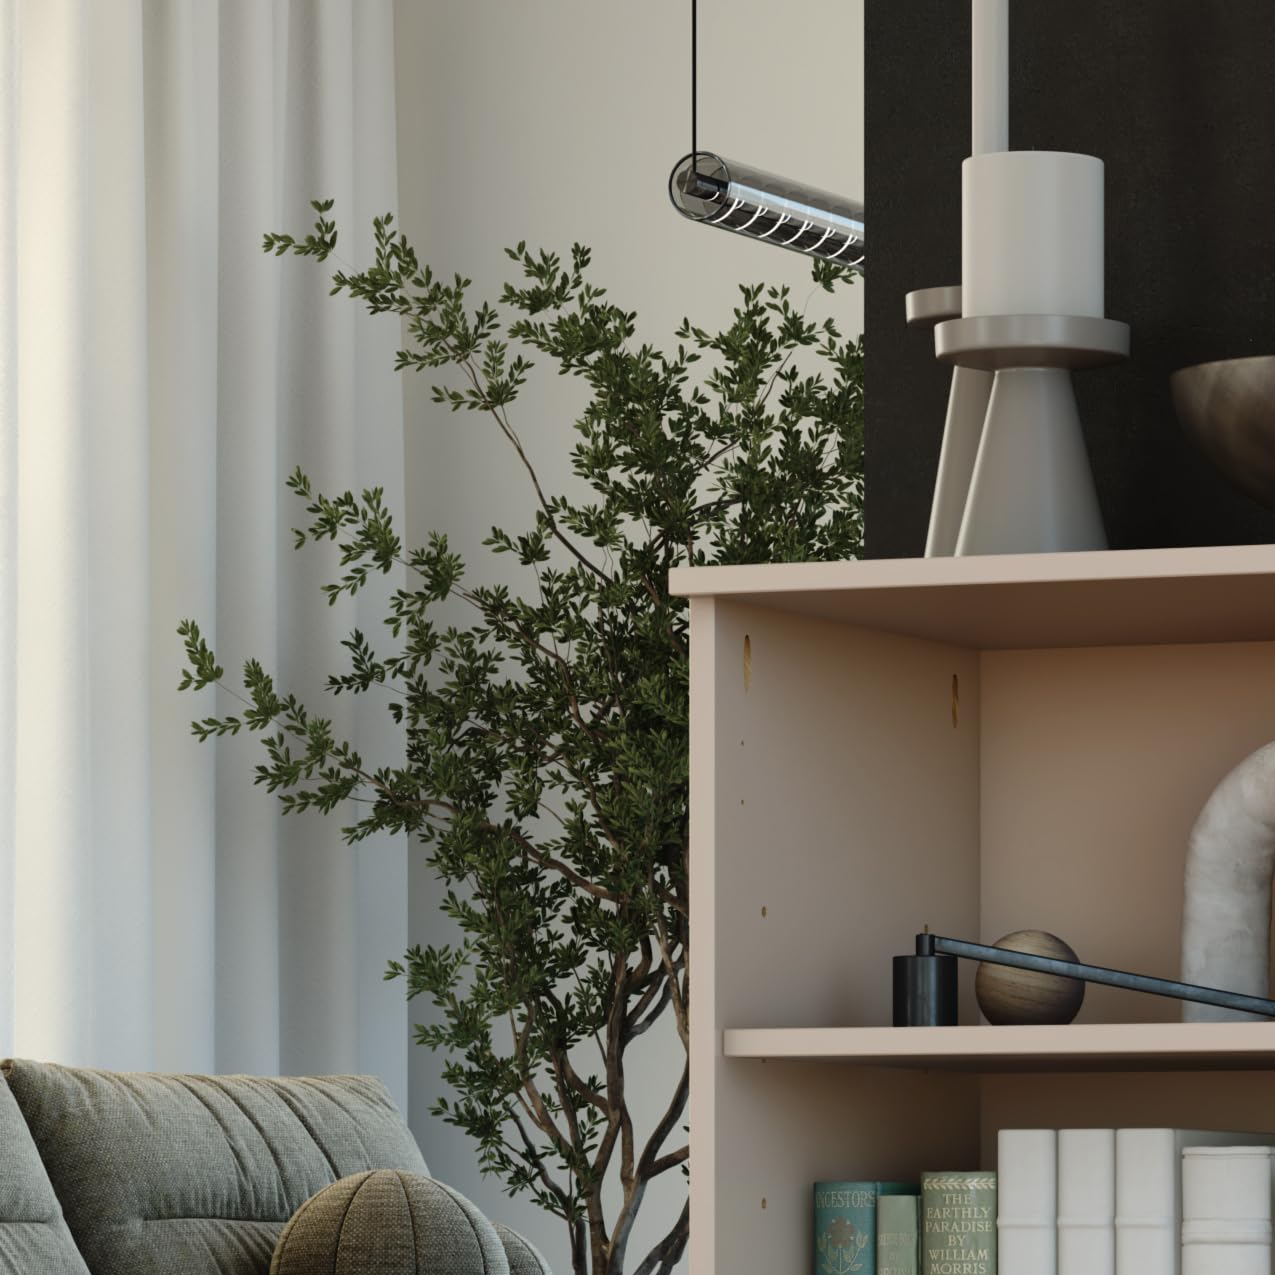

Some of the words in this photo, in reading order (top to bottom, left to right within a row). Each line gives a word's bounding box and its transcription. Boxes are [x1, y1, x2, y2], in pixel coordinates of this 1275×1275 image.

[943, 1193, 972, 1205] THE
[927, 1207, 991, 1219] EARTHLY
[925, 1221, 993, 1233] PARADISE
[948, 1234, 965, 1247] BY
[928, 1249, 988, 1261] WILLIAM
[930, 1263, 986, 1275] MORRIS
